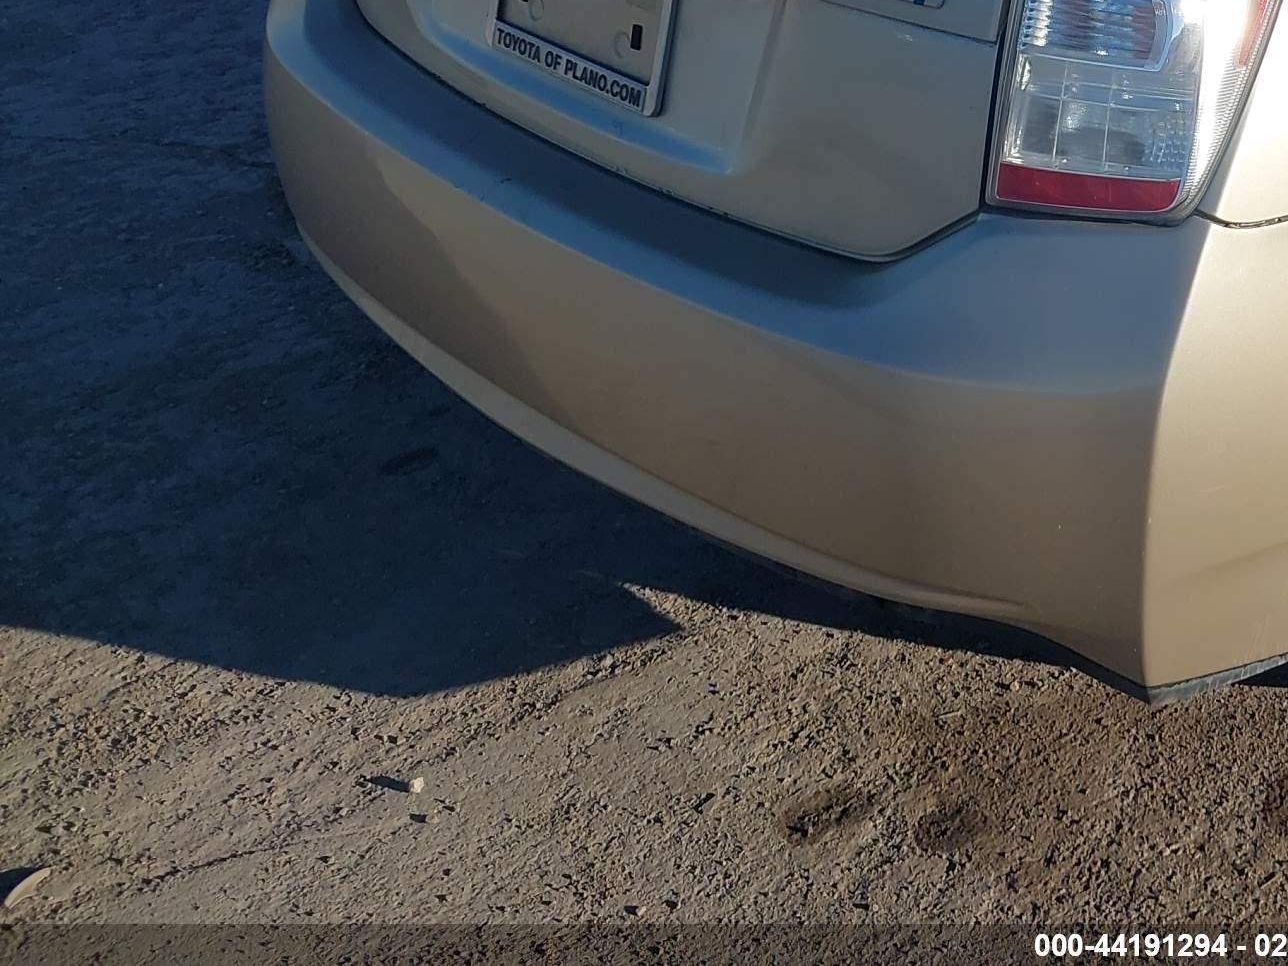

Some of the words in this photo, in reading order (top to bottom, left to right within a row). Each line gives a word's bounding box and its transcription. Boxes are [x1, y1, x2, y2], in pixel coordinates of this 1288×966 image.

[497, 28, 541, 63] TOYOTA
[545, 50, 562, 70] OF
[564, 59, 642, 107] PLANO.COM
